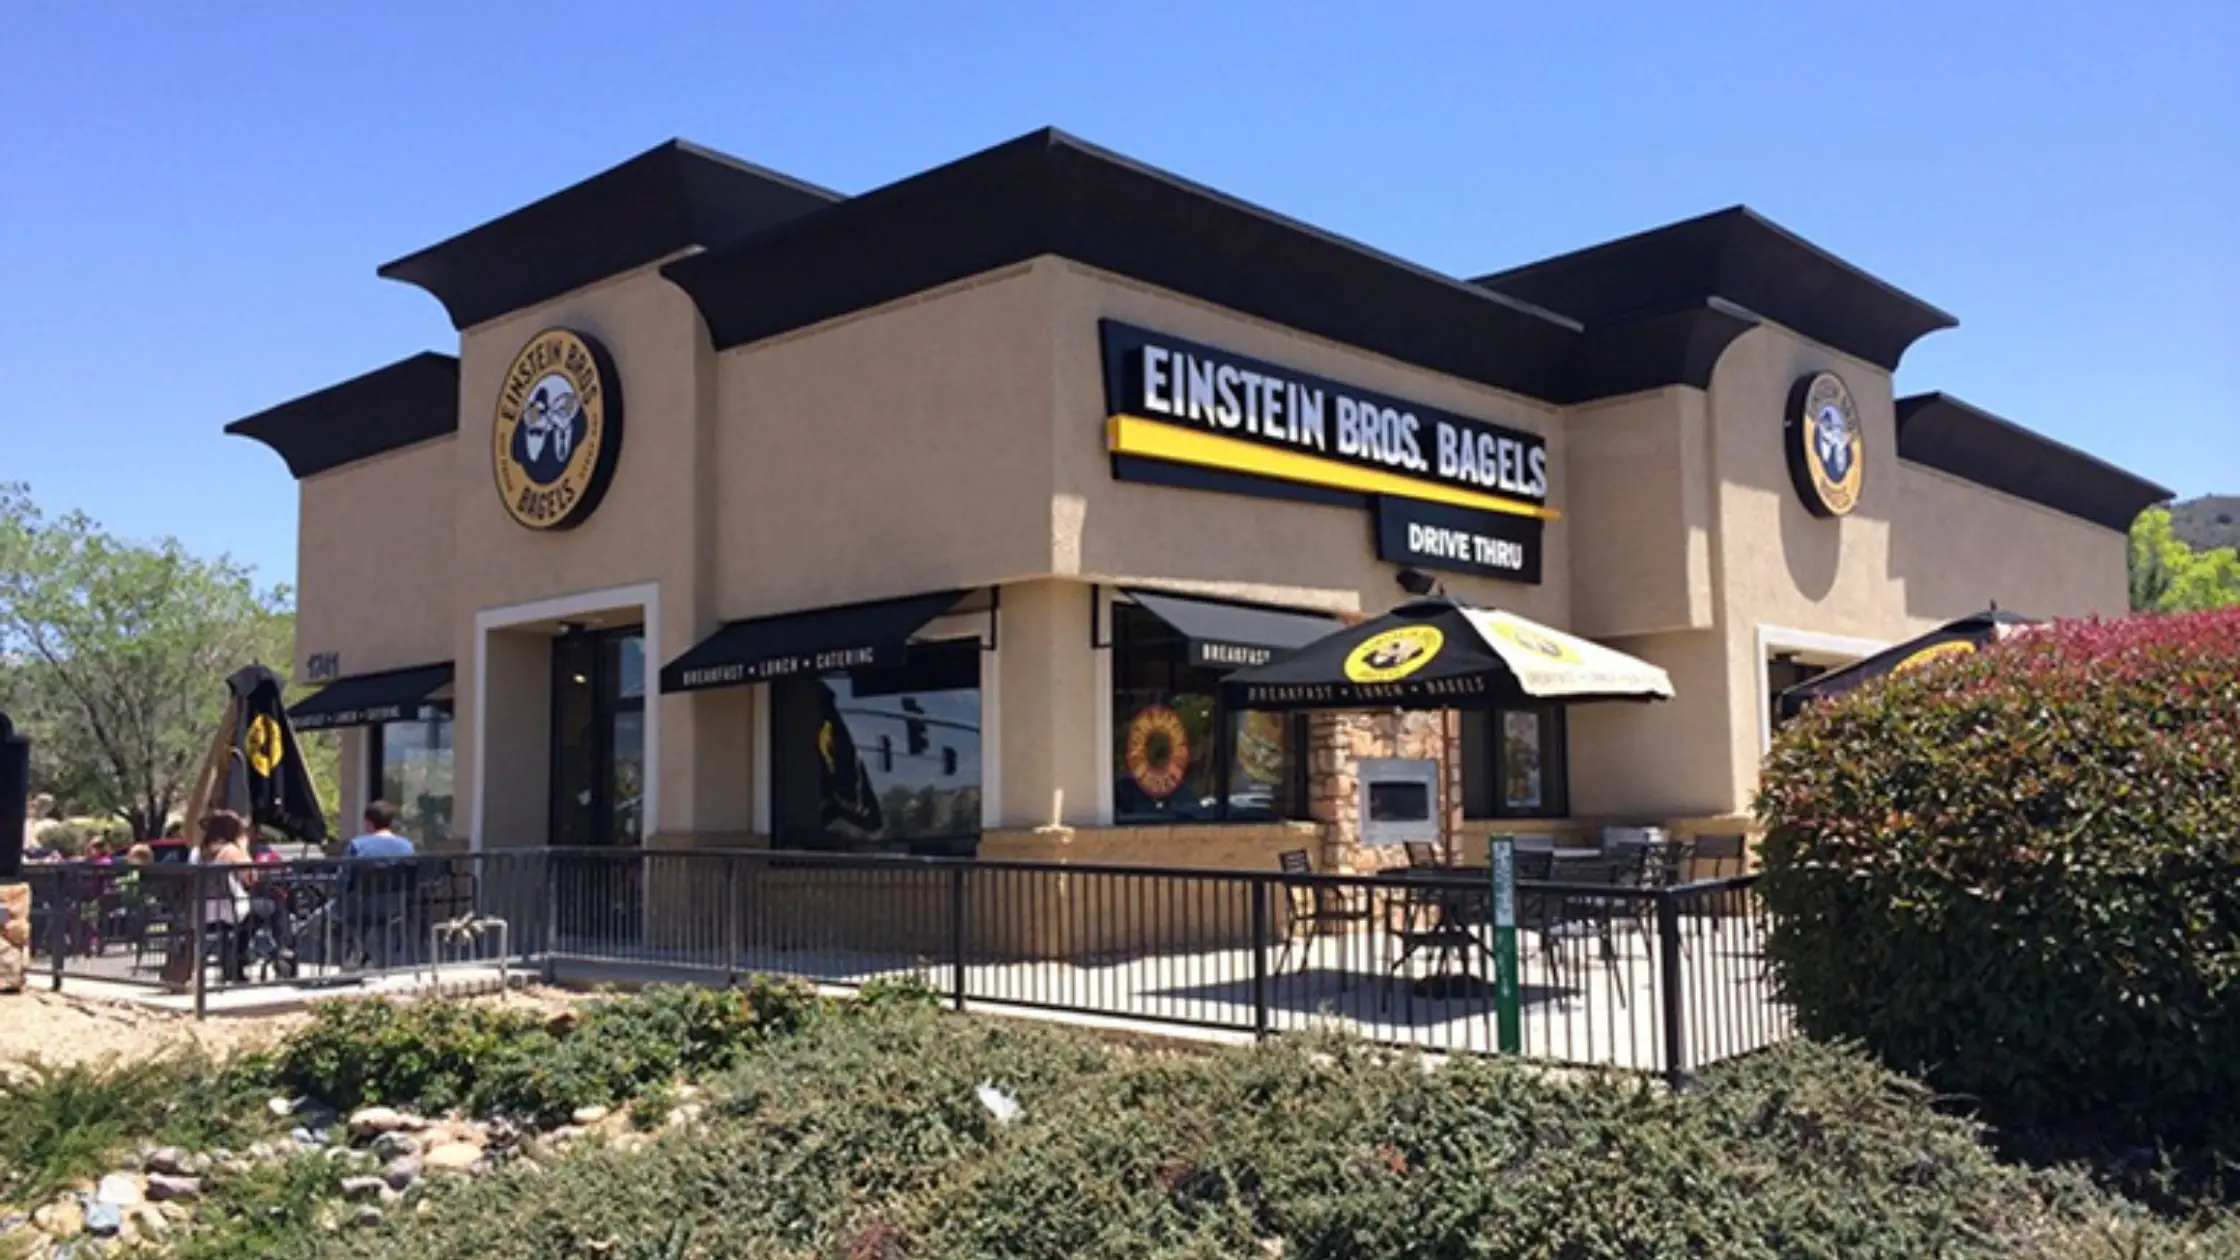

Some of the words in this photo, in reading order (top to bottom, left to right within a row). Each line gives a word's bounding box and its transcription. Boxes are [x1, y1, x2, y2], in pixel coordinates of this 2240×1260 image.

[1142, 344, 1326, 452] EINSTEIN
[1335, 394, 1428, 473] BROS.
[1436, 421, 1548, 498] BAGELS
[1407, 522, 1470, 562] DRIVE
[1474, 534, 1523, 571] THRU
[759, 656, 798, 678] LUNCH
[816, 646, 875, 670] CATERING
[1202, 643, 1271, 666] BREAKFAST
[1248, 684, 1333, 702] BREAKFAST
[1355, 684, 1403, 700] LUNCH
[1426, 675, 1486, 696] BAGELS
